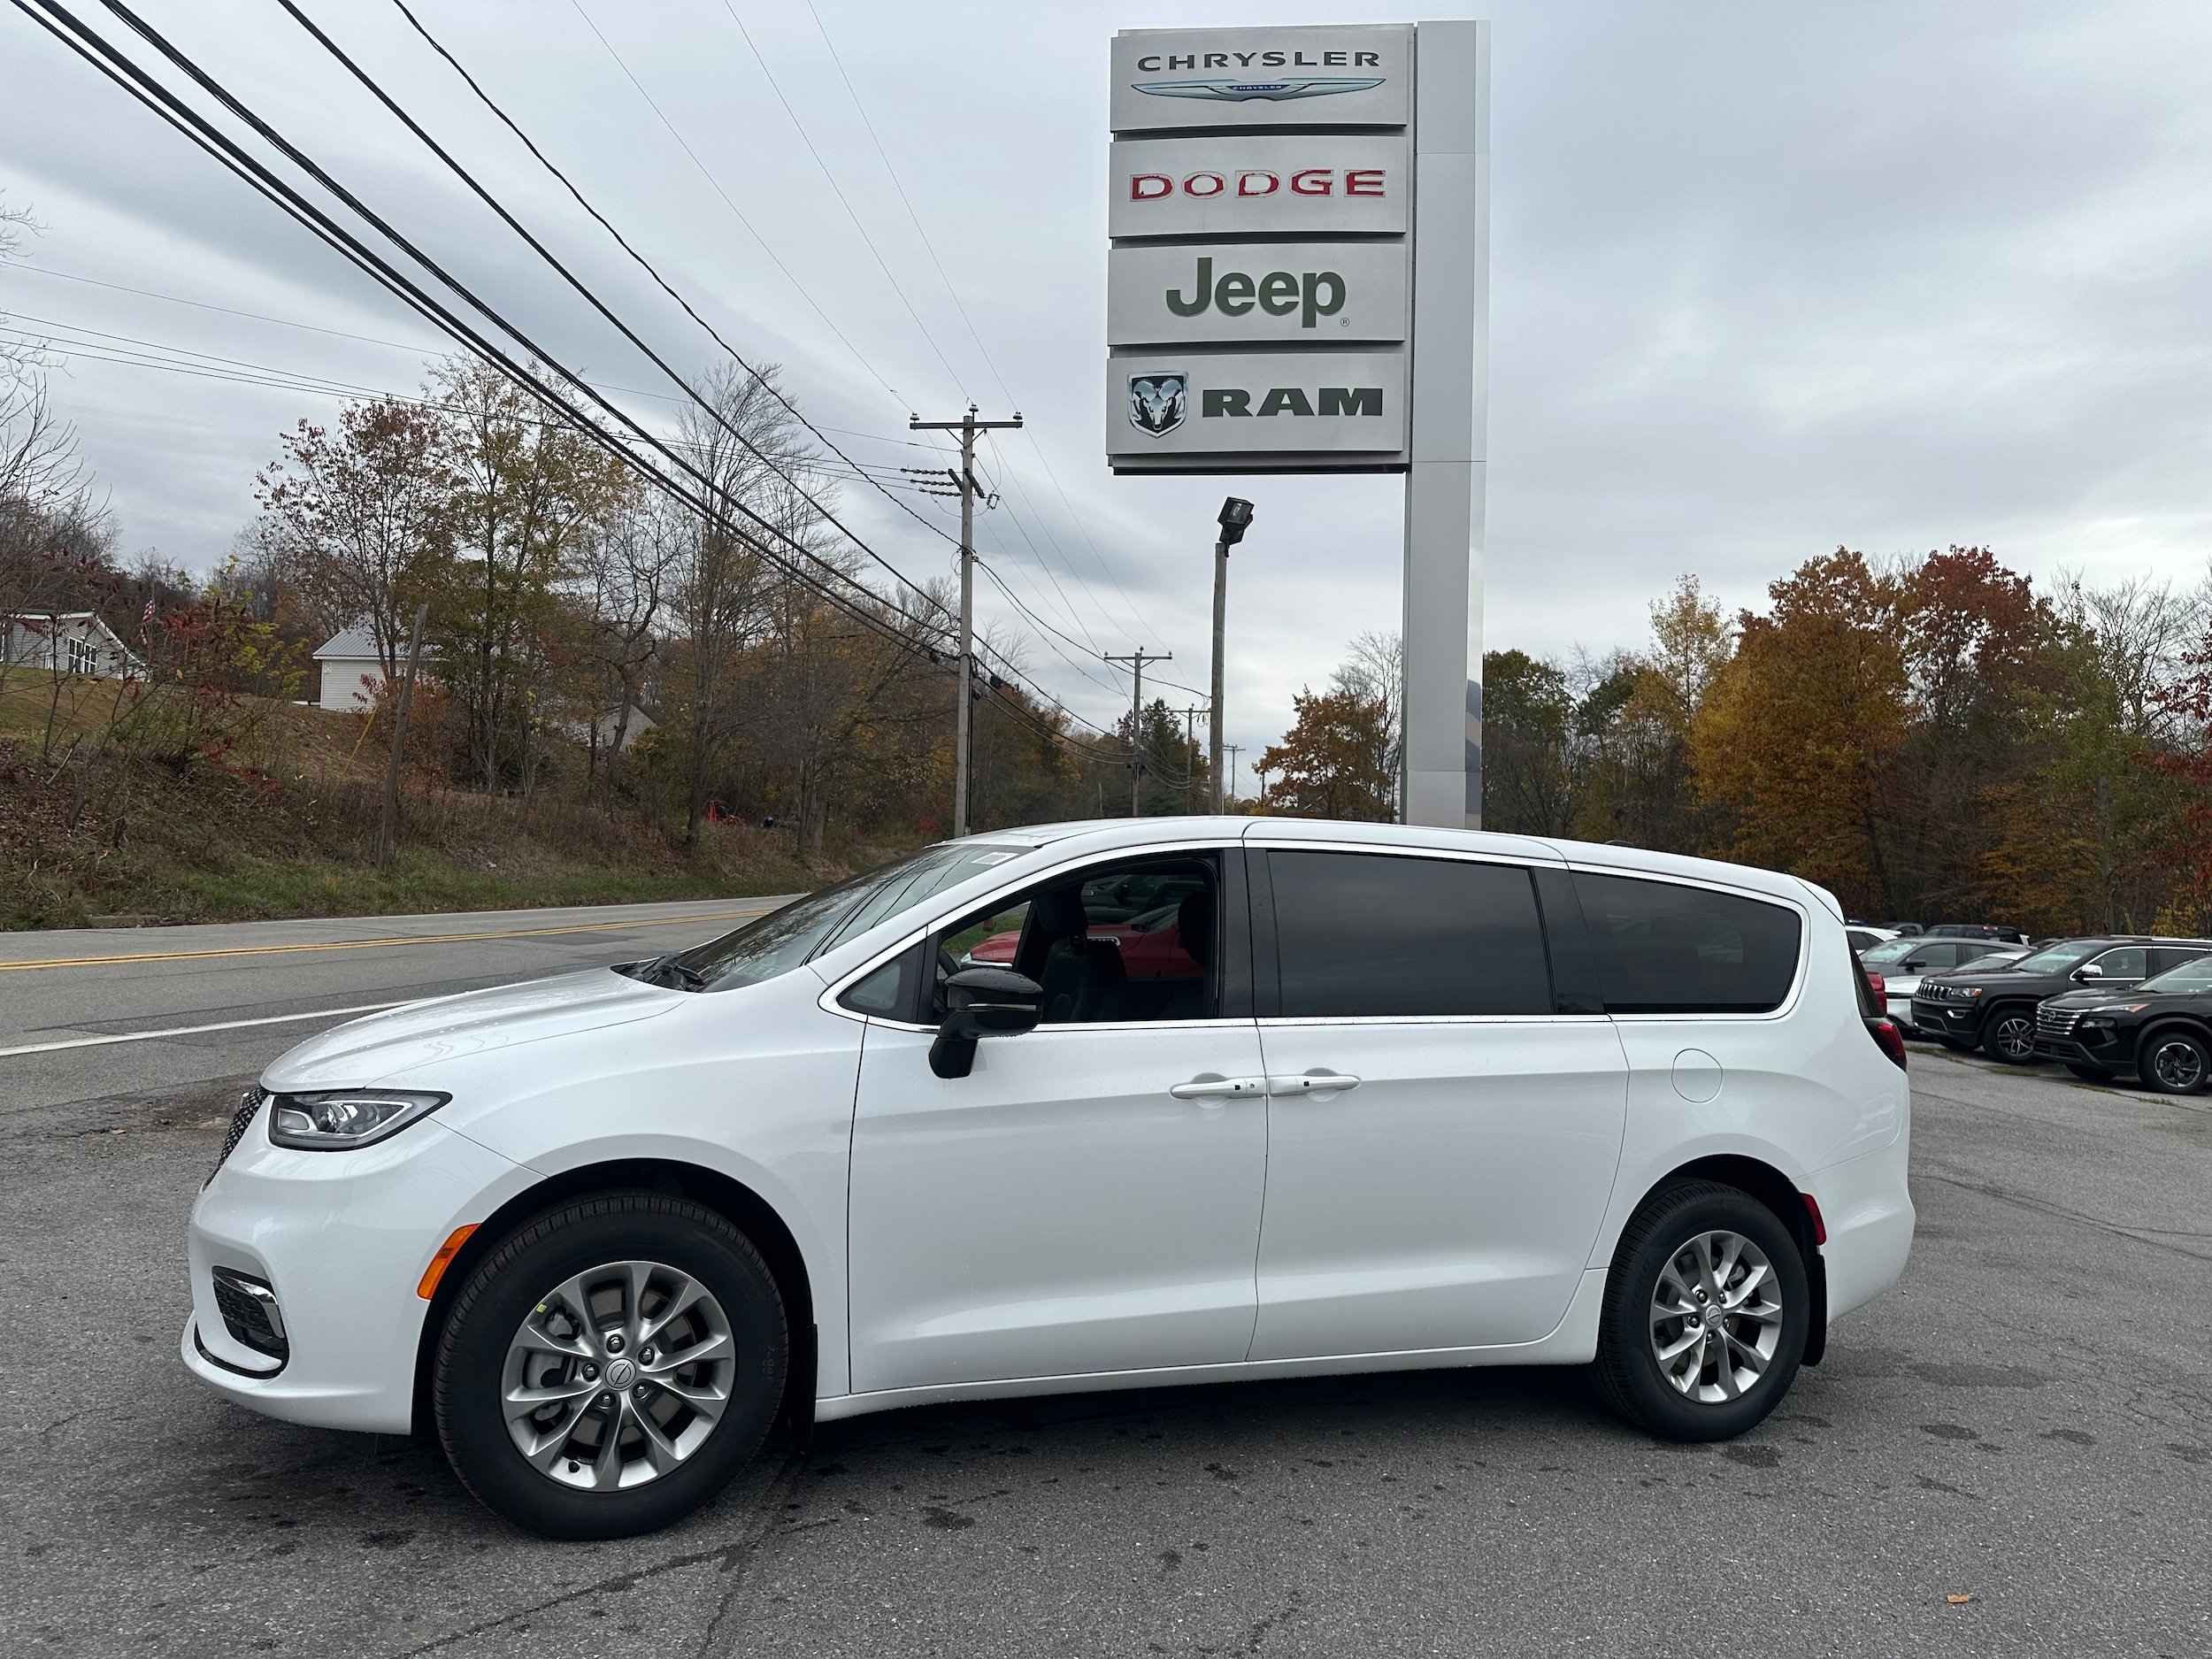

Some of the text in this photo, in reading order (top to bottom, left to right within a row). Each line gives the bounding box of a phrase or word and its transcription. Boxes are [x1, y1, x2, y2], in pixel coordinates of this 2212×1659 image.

[1137, 51, 1380, 72] CHRYSLER
[1130, 169, 1386, 202] DODGE
[1165, 257, 1347, 328] Jeep
[1202, 388, 1383, 419] RAM
